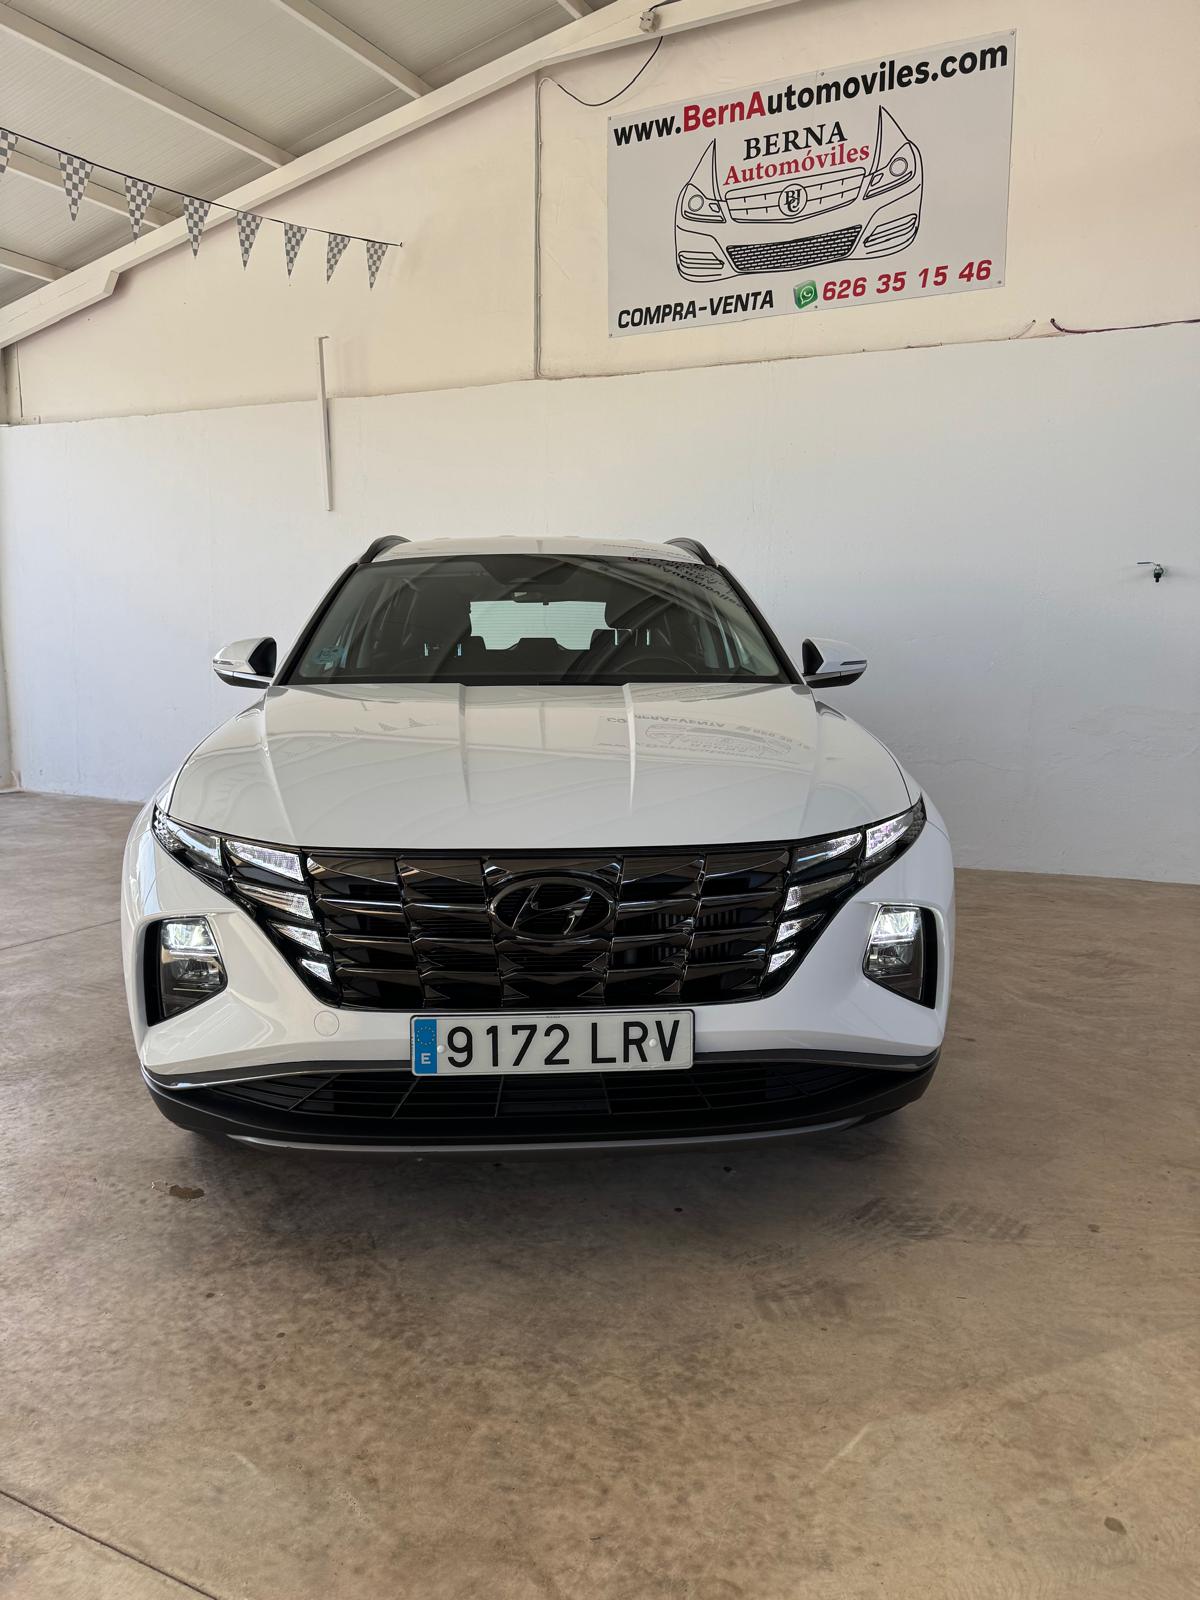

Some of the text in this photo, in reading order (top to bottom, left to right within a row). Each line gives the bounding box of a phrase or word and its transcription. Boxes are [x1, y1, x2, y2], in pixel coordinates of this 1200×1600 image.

[613, 44, 1008, 147] www.BernAutomoviles.com
[743, 121, 848, 161] BERNA
[722, 142, 870, 186] Automóviles
[822, 259, 993, 301] 626 35 15 46
[617, 290, 774, 329] COMPRA-VENTA
[421, 1053, 431, 1064] E
[447, 1024, 571, 1068] 9172
[591, 1020, 680, 1063] LRV
